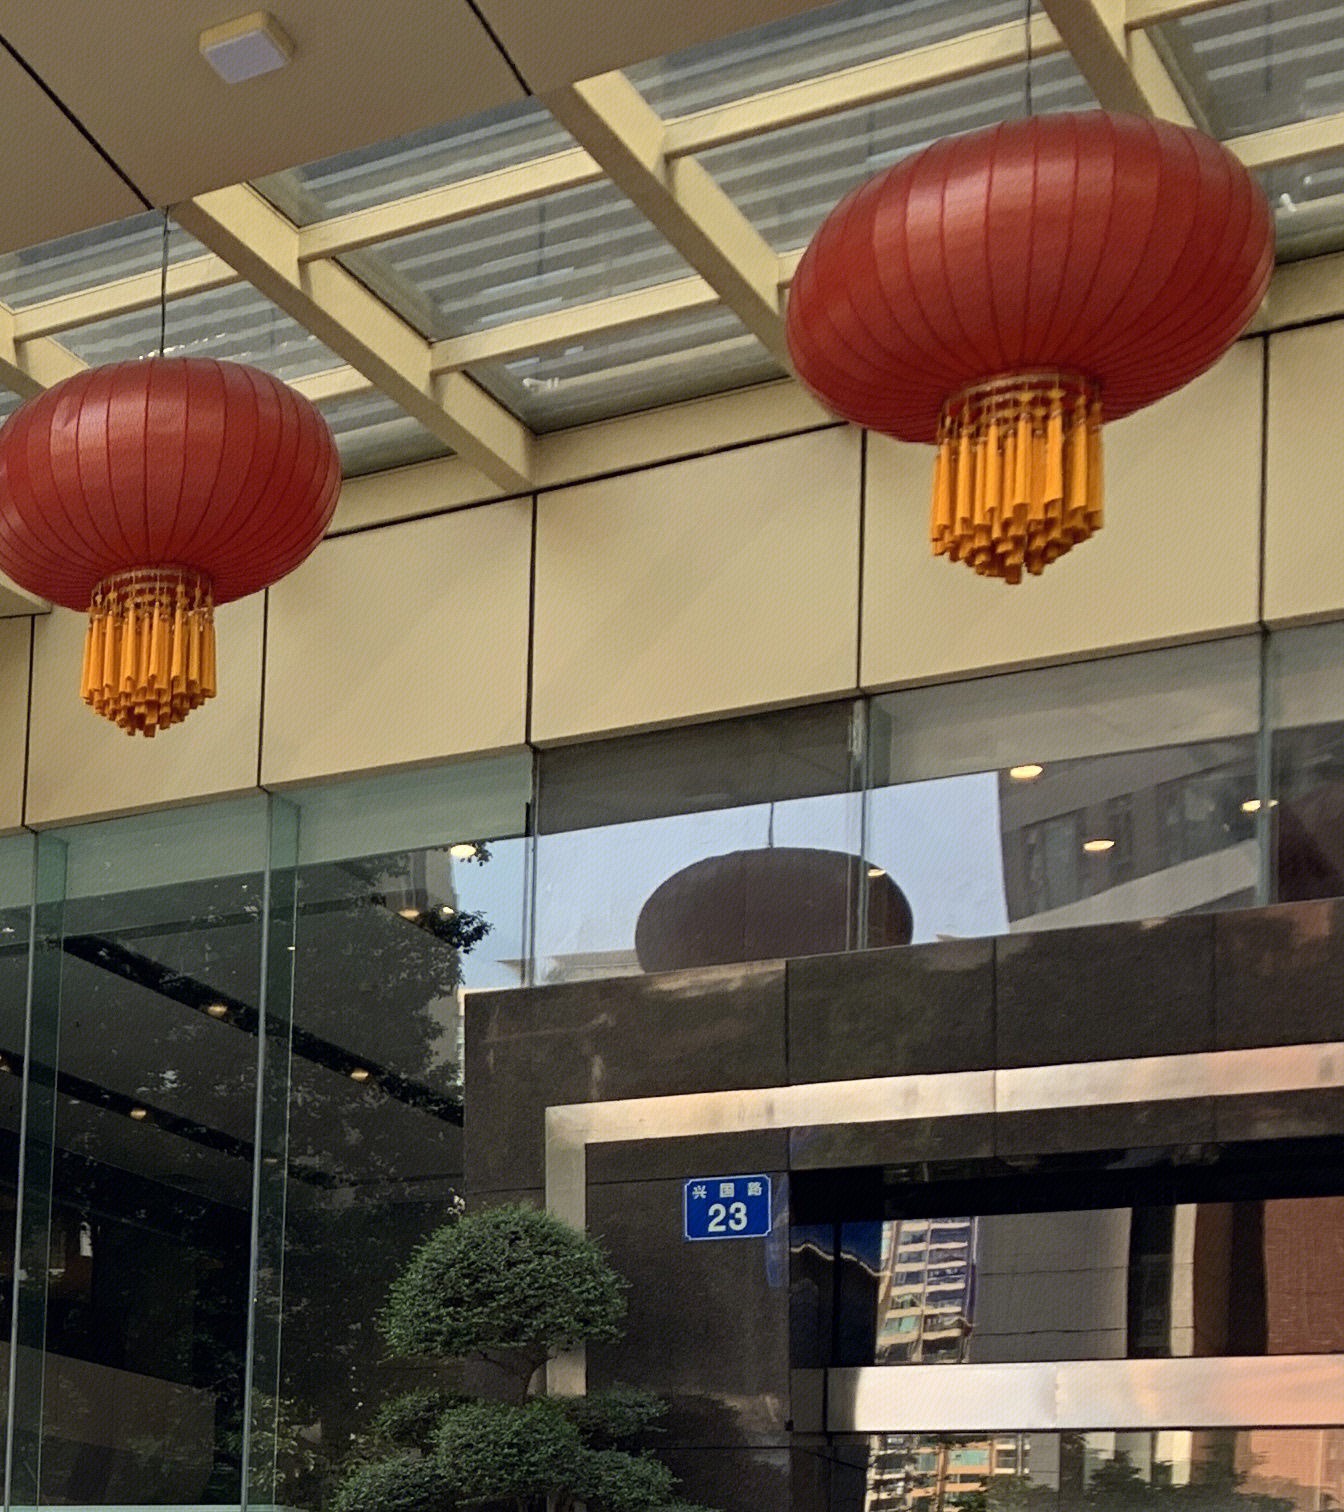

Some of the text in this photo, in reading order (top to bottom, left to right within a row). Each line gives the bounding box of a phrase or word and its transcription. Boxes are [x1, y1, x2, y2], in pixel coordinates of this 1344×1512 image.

[692, 1182, 762, 1199] 兴国路
[708, 1202, 748, 1233] 23
